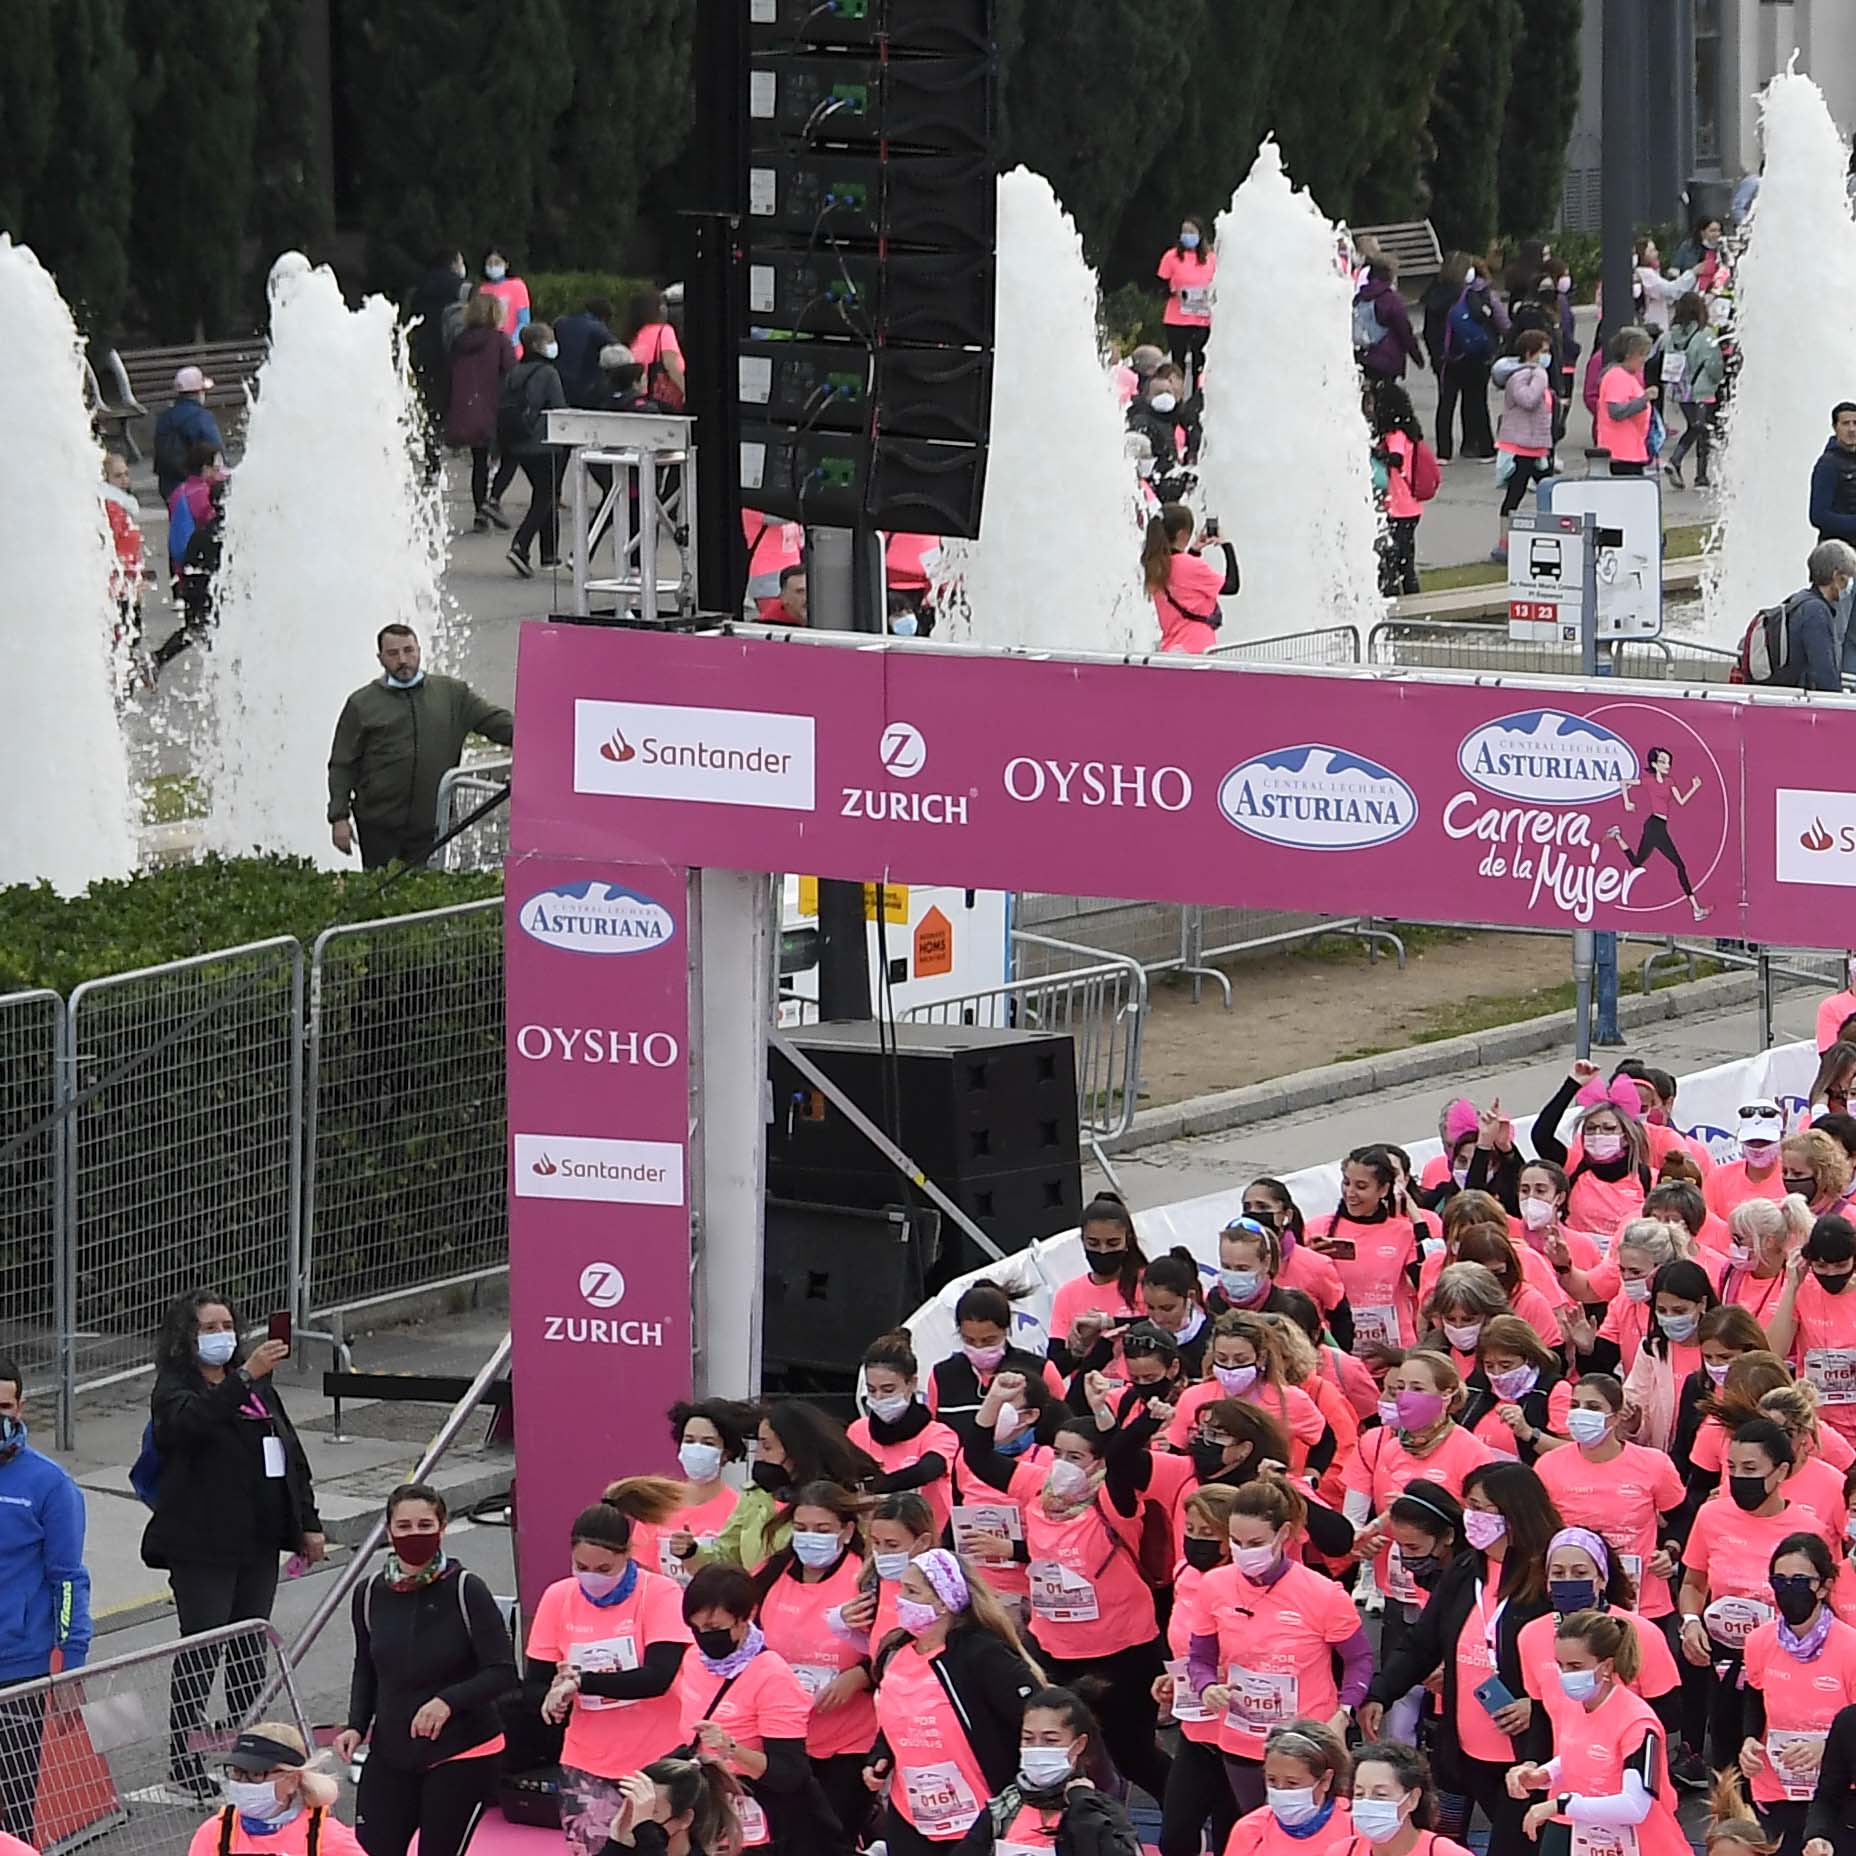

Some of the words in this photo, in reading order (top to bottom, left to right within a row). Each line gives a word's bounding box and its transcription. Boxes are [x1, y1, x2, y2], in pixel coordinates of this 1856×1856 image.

[1515, 605, 1528, 617] 13
[1538, 606, 1552, 619] 23
[640, 737, 792, 774] Santander
[1473, 740, 1622, 784] ASTURIANA
[1002, 757, 1193, 813] OYSHO
[1235, 778, 1400, 827] ASTURIANA
[841, 786, 968, 825] ZURICH
[1442, 791, 1592, 847] Carrera
[1478, 843, 1506, 878] de
[1512, 846, 1532, 880] la
[1529, 839, 1647, 923] Mujer
[530, 904, 663, 939] ASTURIANA
[517, 1025, 679, 1068] OYSHO
[561, 1158, 666, 1183] Santander
[544, 1316, 663, 1346] ZURICH
[1723, 1620, 1754, 1633] 016
[1243, 1696, 1272, 1711] 016
[921, 1791, 949, 1807] 016
